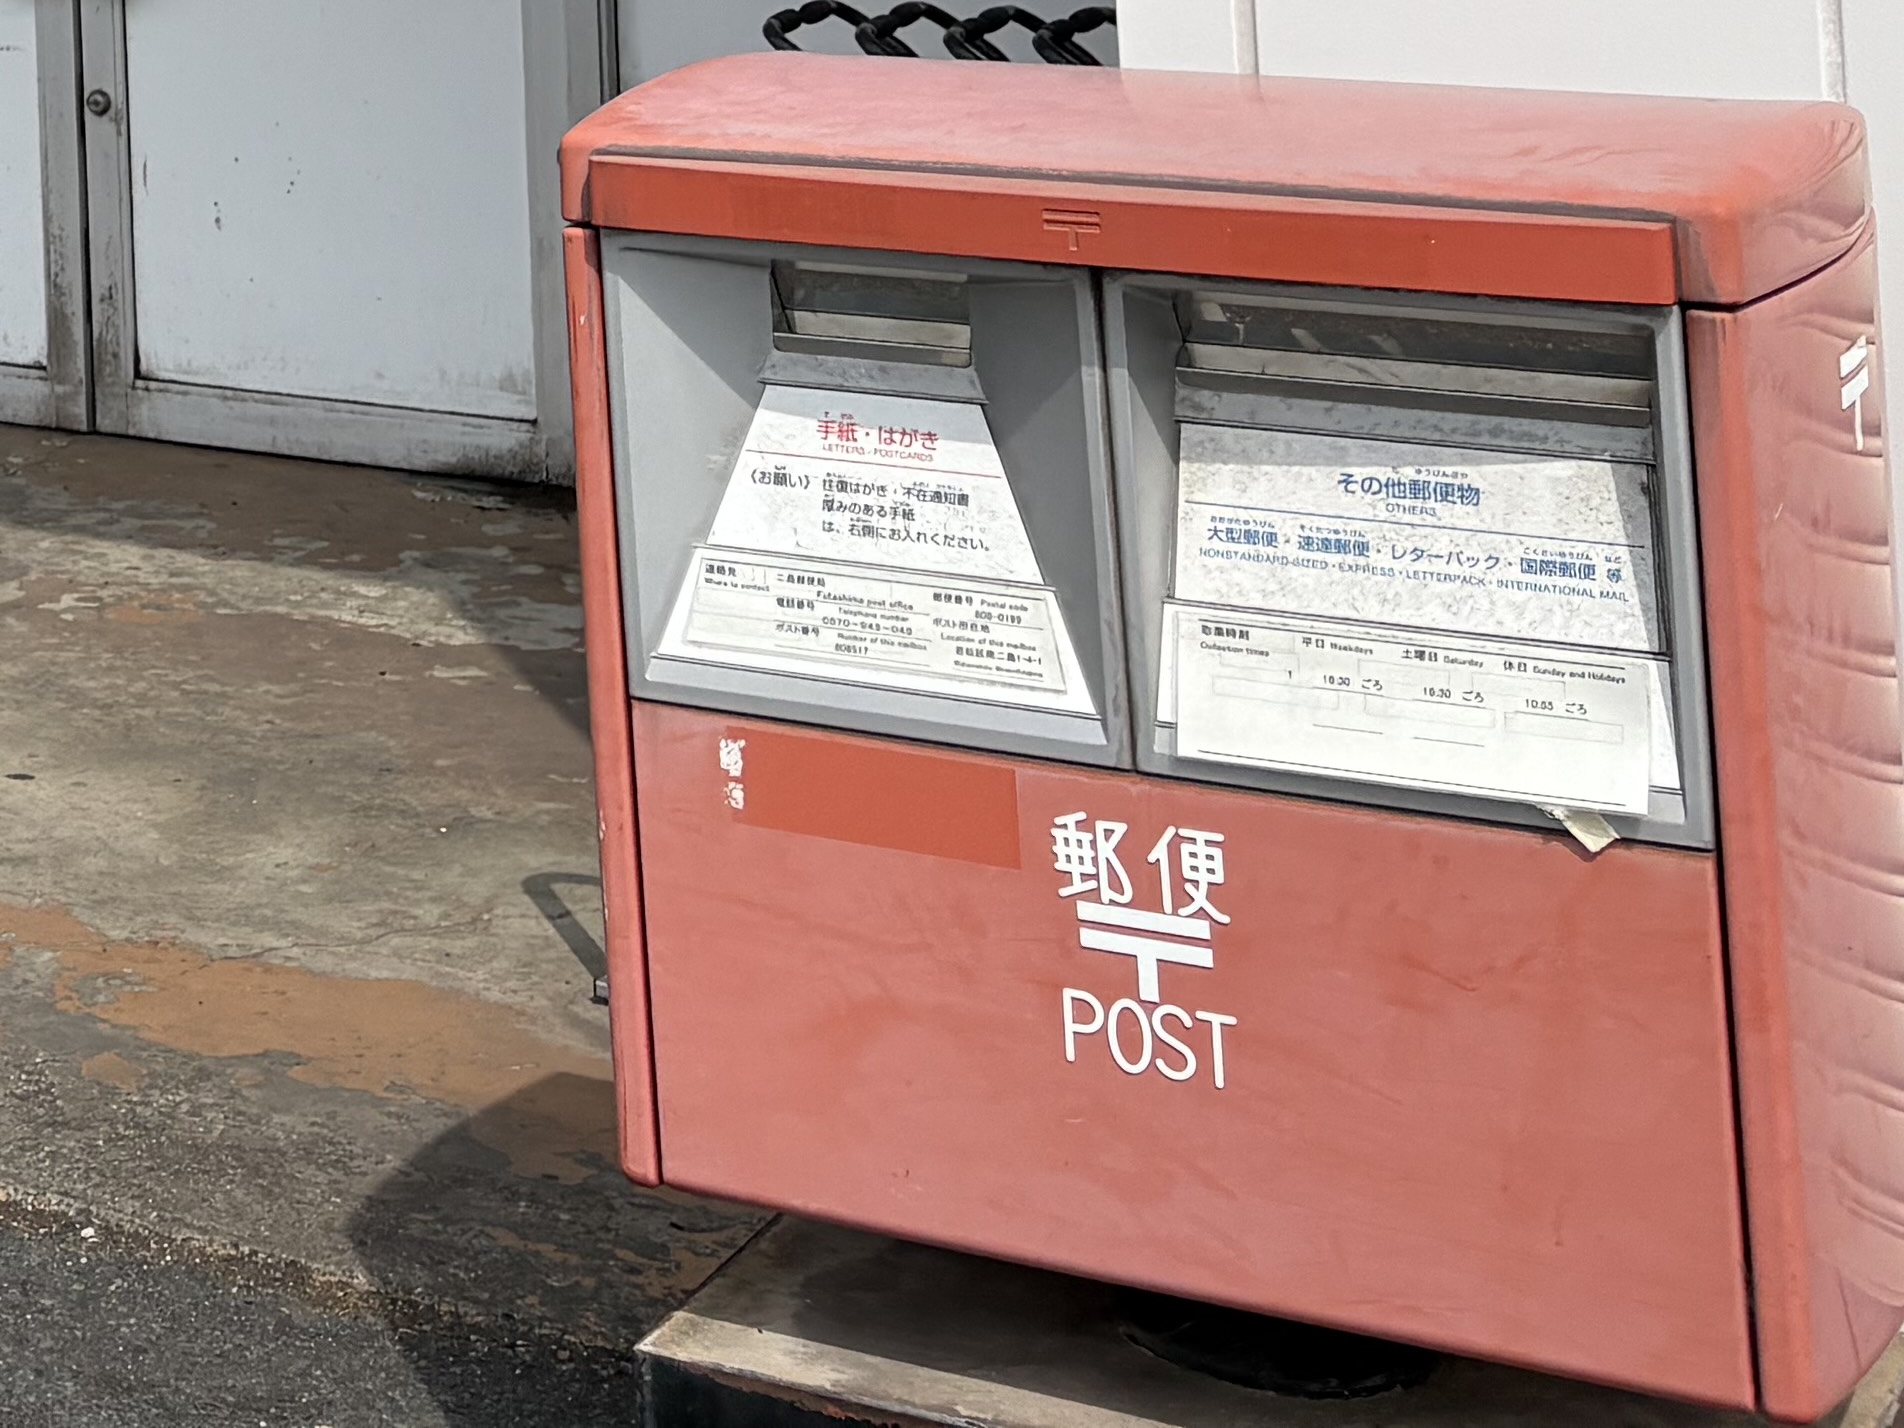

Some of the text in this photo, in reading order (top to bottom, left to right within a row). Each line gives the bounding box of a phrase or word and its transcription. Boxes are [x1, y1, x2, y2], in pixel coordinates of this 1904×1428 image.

[816, 419, 941, 452] 手紙・はがき
[1338, 472, 1481, 507] その他郵便物
[821, 498, 916, 522] 厚みのある手紙
[1385, 502, 1438, 518] OTHERS
[821, 520, 990, 552] は、右側にお入れください。
[1496, 578, 1596, 599] INTERNATIONAL
[1598, 589, 1630, 603] MAIL
[1302, 636, 1325, 650] 平日
[1401, 648, 1438, 663] 土曜日
[1503, 659, 1528, 673] 休日
[1361, 678, 1383, 691] ごろ
[1461, 690, 1485, 703] ごろ
[1564, 703, 1588, 716] ごろ
[1050, 811, 1232, 925] 郵便
[1062, 987, 1238, 1090] POST
